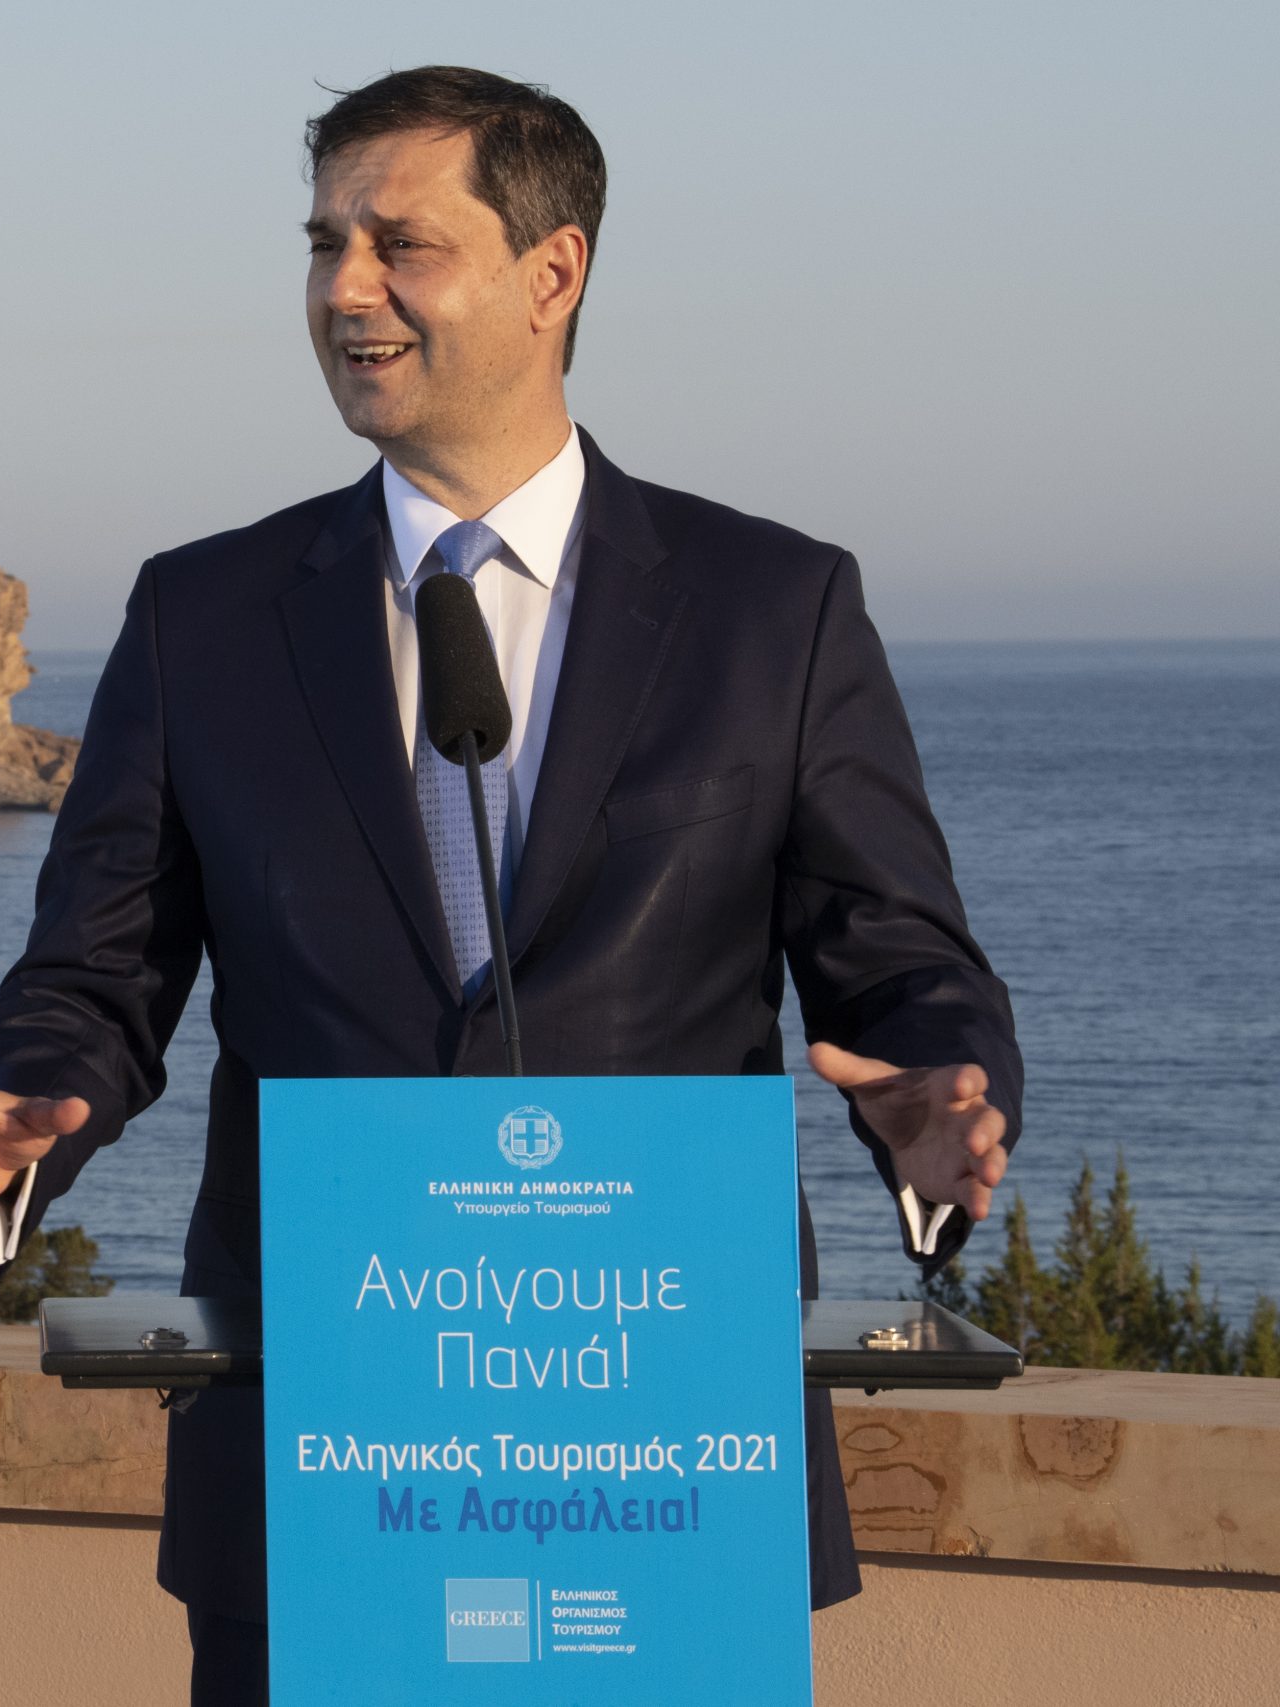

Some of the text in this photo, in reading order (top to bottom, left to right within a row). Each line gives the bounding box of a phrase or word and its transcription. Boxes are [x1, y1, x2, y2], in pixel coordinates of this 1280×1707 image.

[428, 1181, 634, 1196] ΕΛΛΗΝΙΚΗ ΔΗΜΟΚΡΑΤΙΑ
[453, 1200, 611, 1217] Υπουργείο Τουρισμού
[355, 1253, 687, 1326] Ανοίγουμε
[437, 1331, 629, 1390] Πανιά!
[298, 1433, 777, 1481] Ελληνικός Τουρισμός 2021
[378, 1487, 699, 1545] Με Ασφάλεια!
[551, 1588, 619, 1602] ΕΛΛΗΝΙΚΟΣ
[449, 1610, 526, 1627] GREECE
[551, 1606, 628, 1619] ΟΡΓΑΝΙΣΜΟΣ
[551, 1622, 622, 1636] ΤΟΥΡΙΣΜΟΥ
[552, 1643, 637, 1655] www.visitgreece.gr
